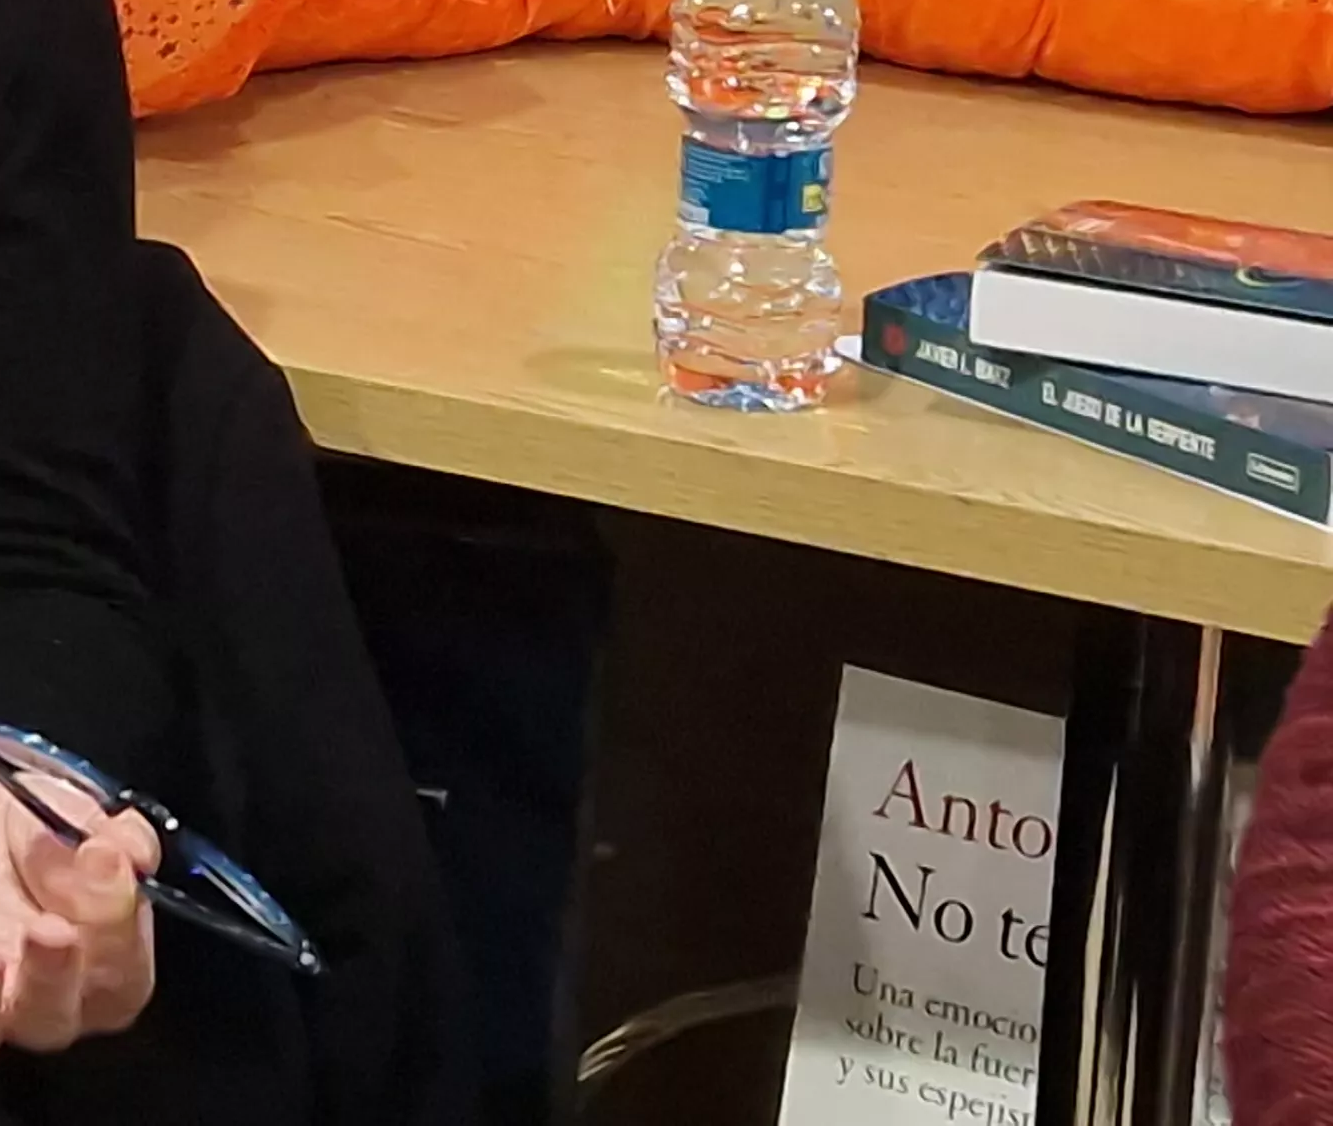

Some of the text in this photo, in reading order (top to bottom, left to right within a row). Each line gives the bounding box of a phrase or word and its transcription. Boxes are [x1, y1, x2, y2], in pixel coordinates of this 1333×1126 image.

[1042, 381, 1217, 461] EL JUEGO DE LA SERPIENTE
[872, 758, 1052, 859] Anto
[861, 850, 974, 944] No
[853, 961, 1038, 1044] Una emocio
[837, 1054, 855, 1085] y
[864, 1062, 910, 1094] sus
[844, 1012, 1035, 1090] sobre la fuer
